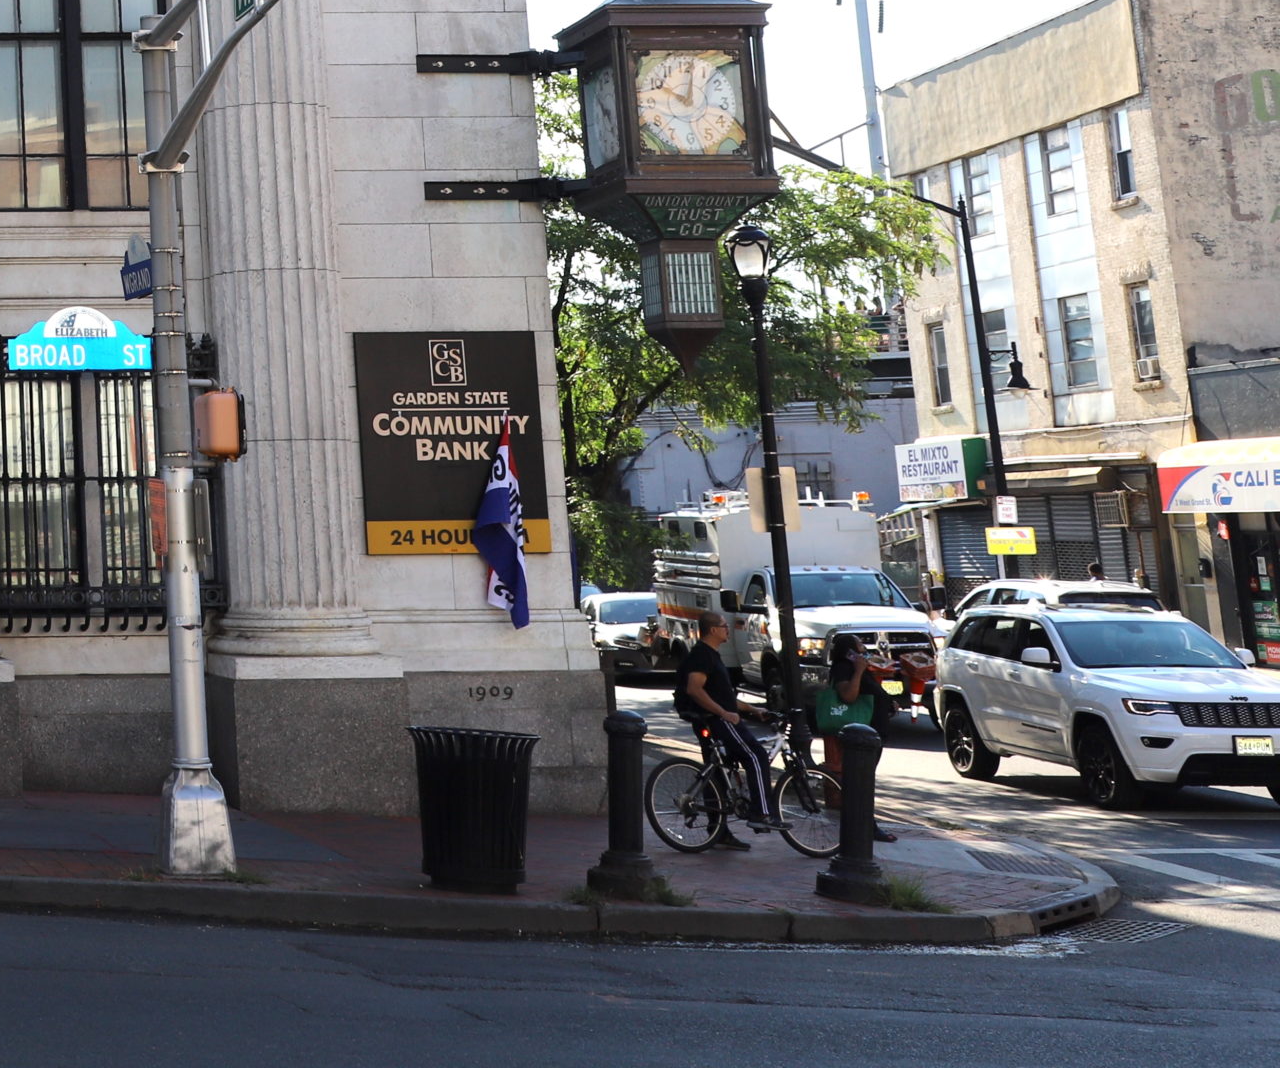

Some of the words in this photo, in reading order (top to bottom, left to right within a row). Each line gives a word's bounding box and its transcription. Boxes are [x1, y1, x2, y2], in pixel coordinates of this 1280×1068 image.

[651, 77, 664, 90] 10
[713, 79, 723, 91] 2
[647, 96, 656, 109] 9
[720, 97, 729, 110] 3
[654, 114, 662, 127] 8
[716, 115, 726, 128] 4
[668, 128, 675, 140] 7
[686, 133, 695, 145] 6
[704, 128, 713, 141] 5
[644, 195, 692, 207] UNION
[695, 195, 753, 207] COUNTY
[668, 208, 724, 221] TRUST
[55, 327, 108, 338] ELIZABETH
[15, 344, 86, 366] BROAD
[123, 344, 147, 366] ST
[392, 392, 460, 405] GARDEN
[464, 391, 509, 404] STATE
[415, 438, 491, 461] BANK
[908, 449, 920, 462] EL
[921, 445, 949, 462] MIXTO
[901, 460, 959, 478] RESTAURANT
[1234, 470, 1268, 487] CALI
[391, 530, 415, 545] 24
[422, 529, 476, 545] HOU
[468, 686, 513, 701] 1909
